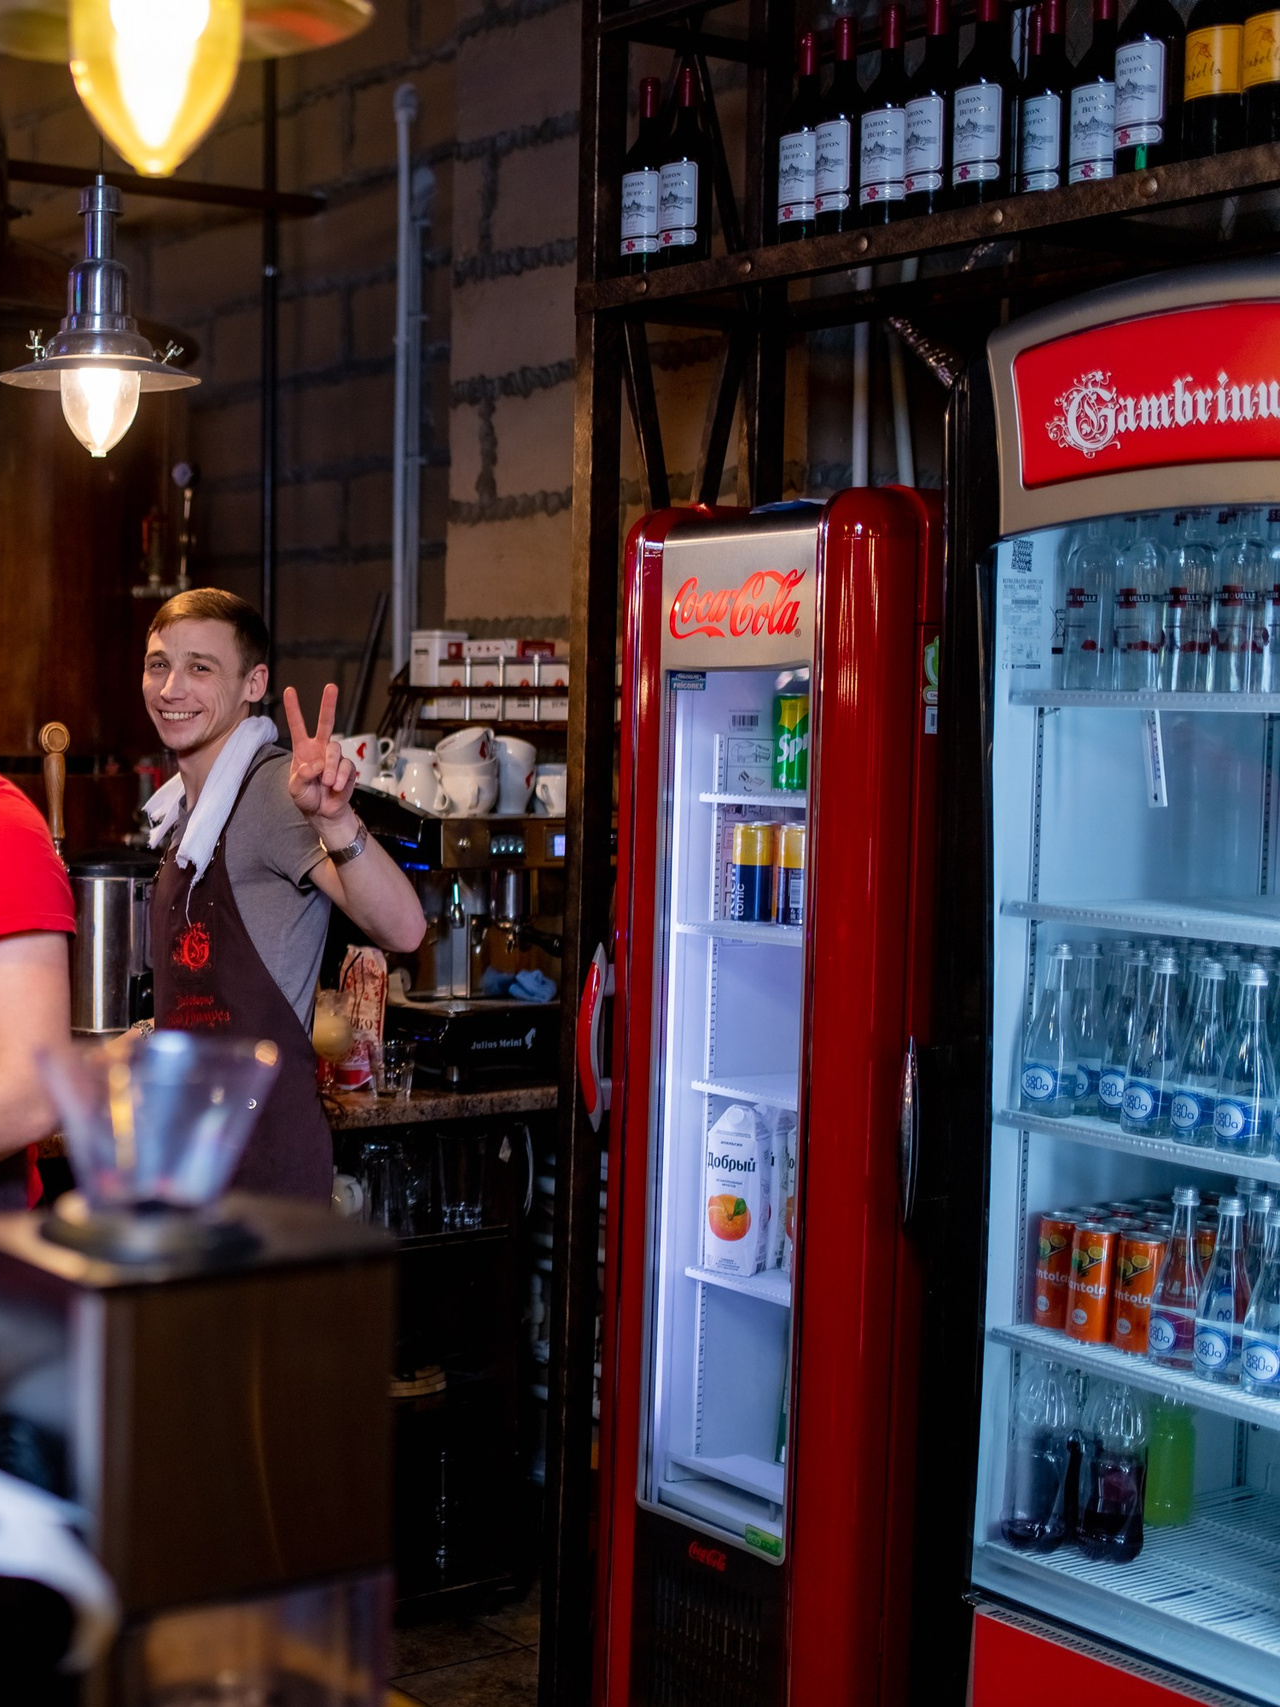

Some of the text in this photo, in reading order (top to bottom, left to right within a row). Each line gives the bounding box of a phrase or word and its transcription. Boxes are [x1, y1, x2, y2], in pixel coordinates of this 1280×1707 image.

[1044, 370, 1280, 459] Gambrinu
[670, 568, 807, 639] Coca-Cola
[735, 883, 745, 917] tonic
[471, 1038, 522, 1050] Julius Meinl
[707, 1152, 756, 1173] Добрый
